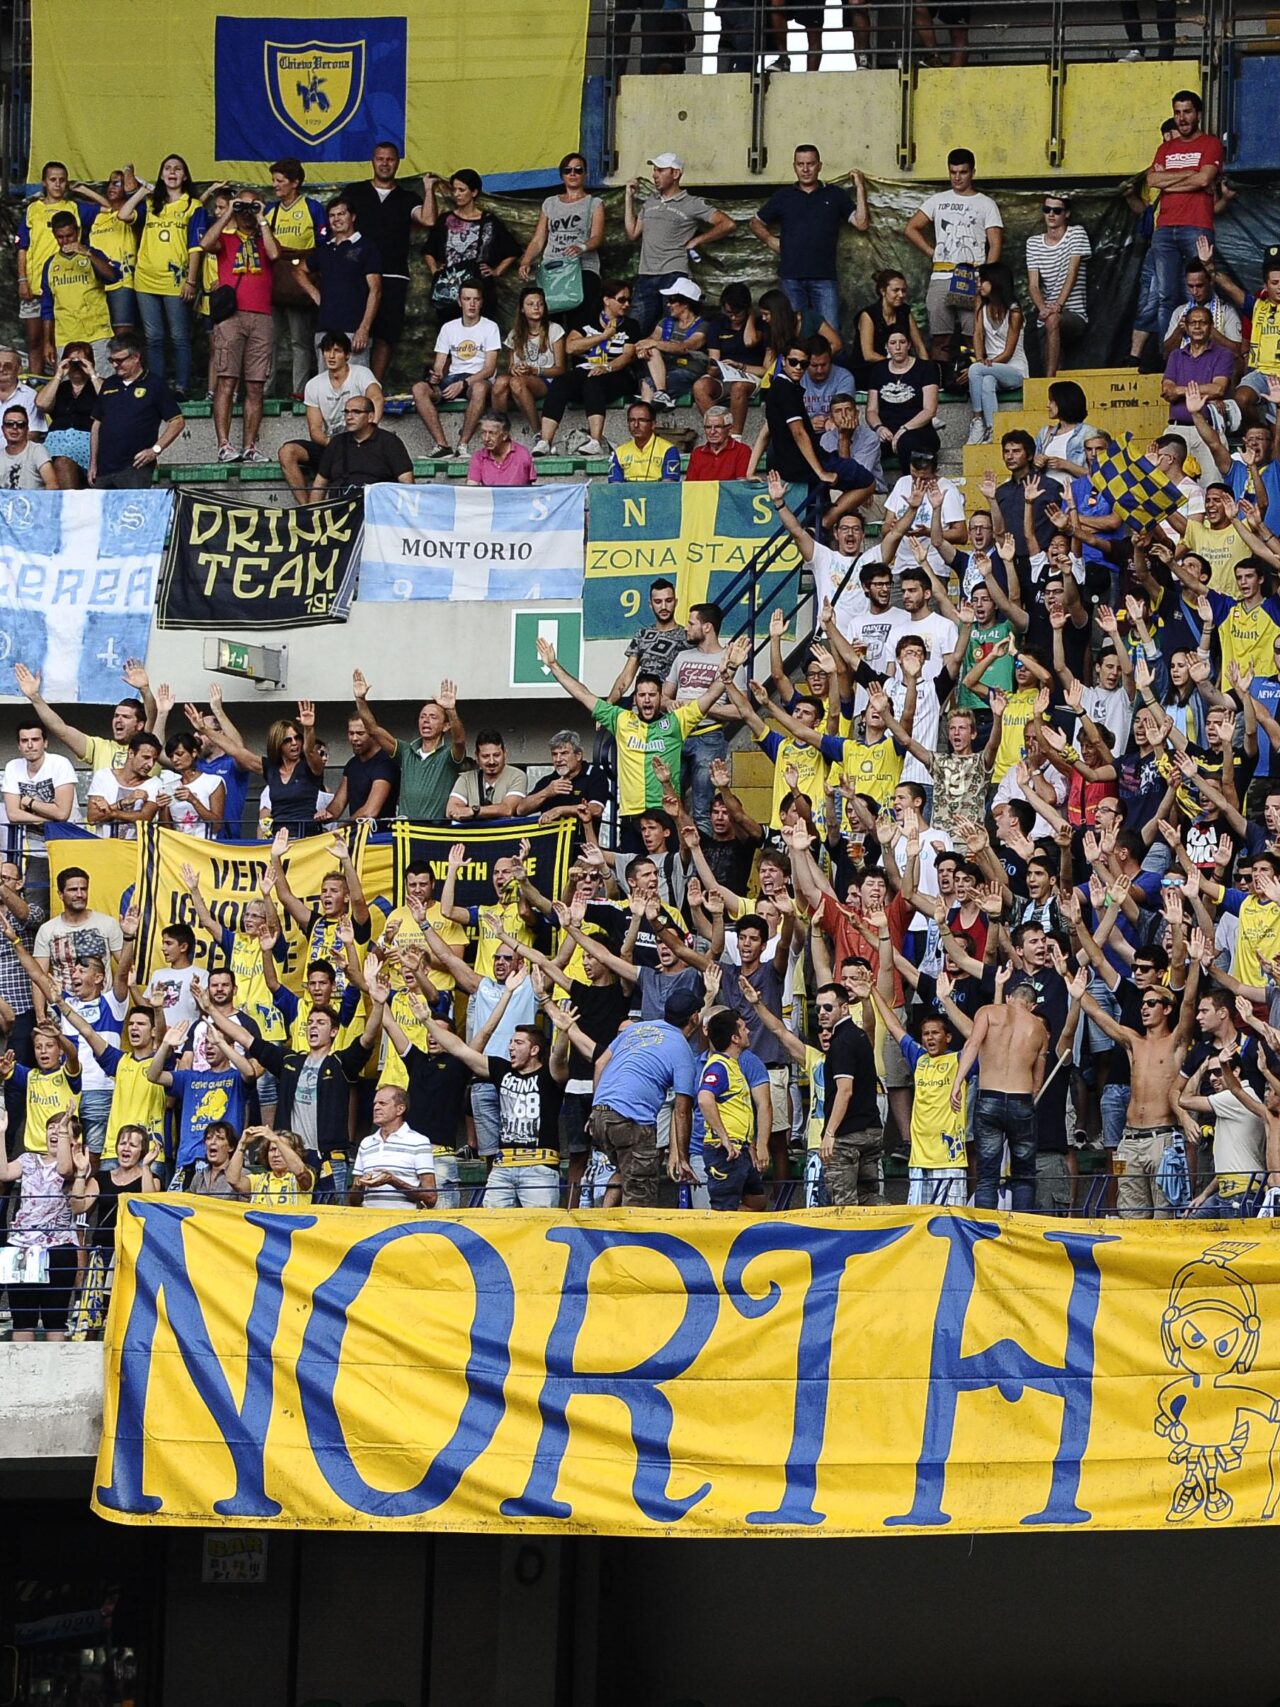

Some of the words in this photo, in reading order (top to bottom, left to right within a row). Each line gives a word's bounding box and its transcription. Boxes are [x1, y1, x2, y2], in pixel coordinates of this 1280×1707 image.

[938, 203, 950, 211] TOP
[1110, 383, 1125, 392] FILA
[395, 490, 421, 518] N
[528, 494, 553, 522] S
[622, 498, 647, 528] N
[753, 492, 773, 525] S
[188, 501, 358, 553] DRINK
[401, 537, 534, 562] MONTORIO
[590, 546, 678, 570] ZONA
[196, 549, 341, 600] TEAM
[391, 578, 414, 601] 9
[619, 588, 642, 618] 9
[680, 662, 719, 671] JAMESON
[1257, 688, 1275, 699] NEW
[513, 1092, 541, 1119] 68
[96, 1199, 1122, 1528] NORTH
